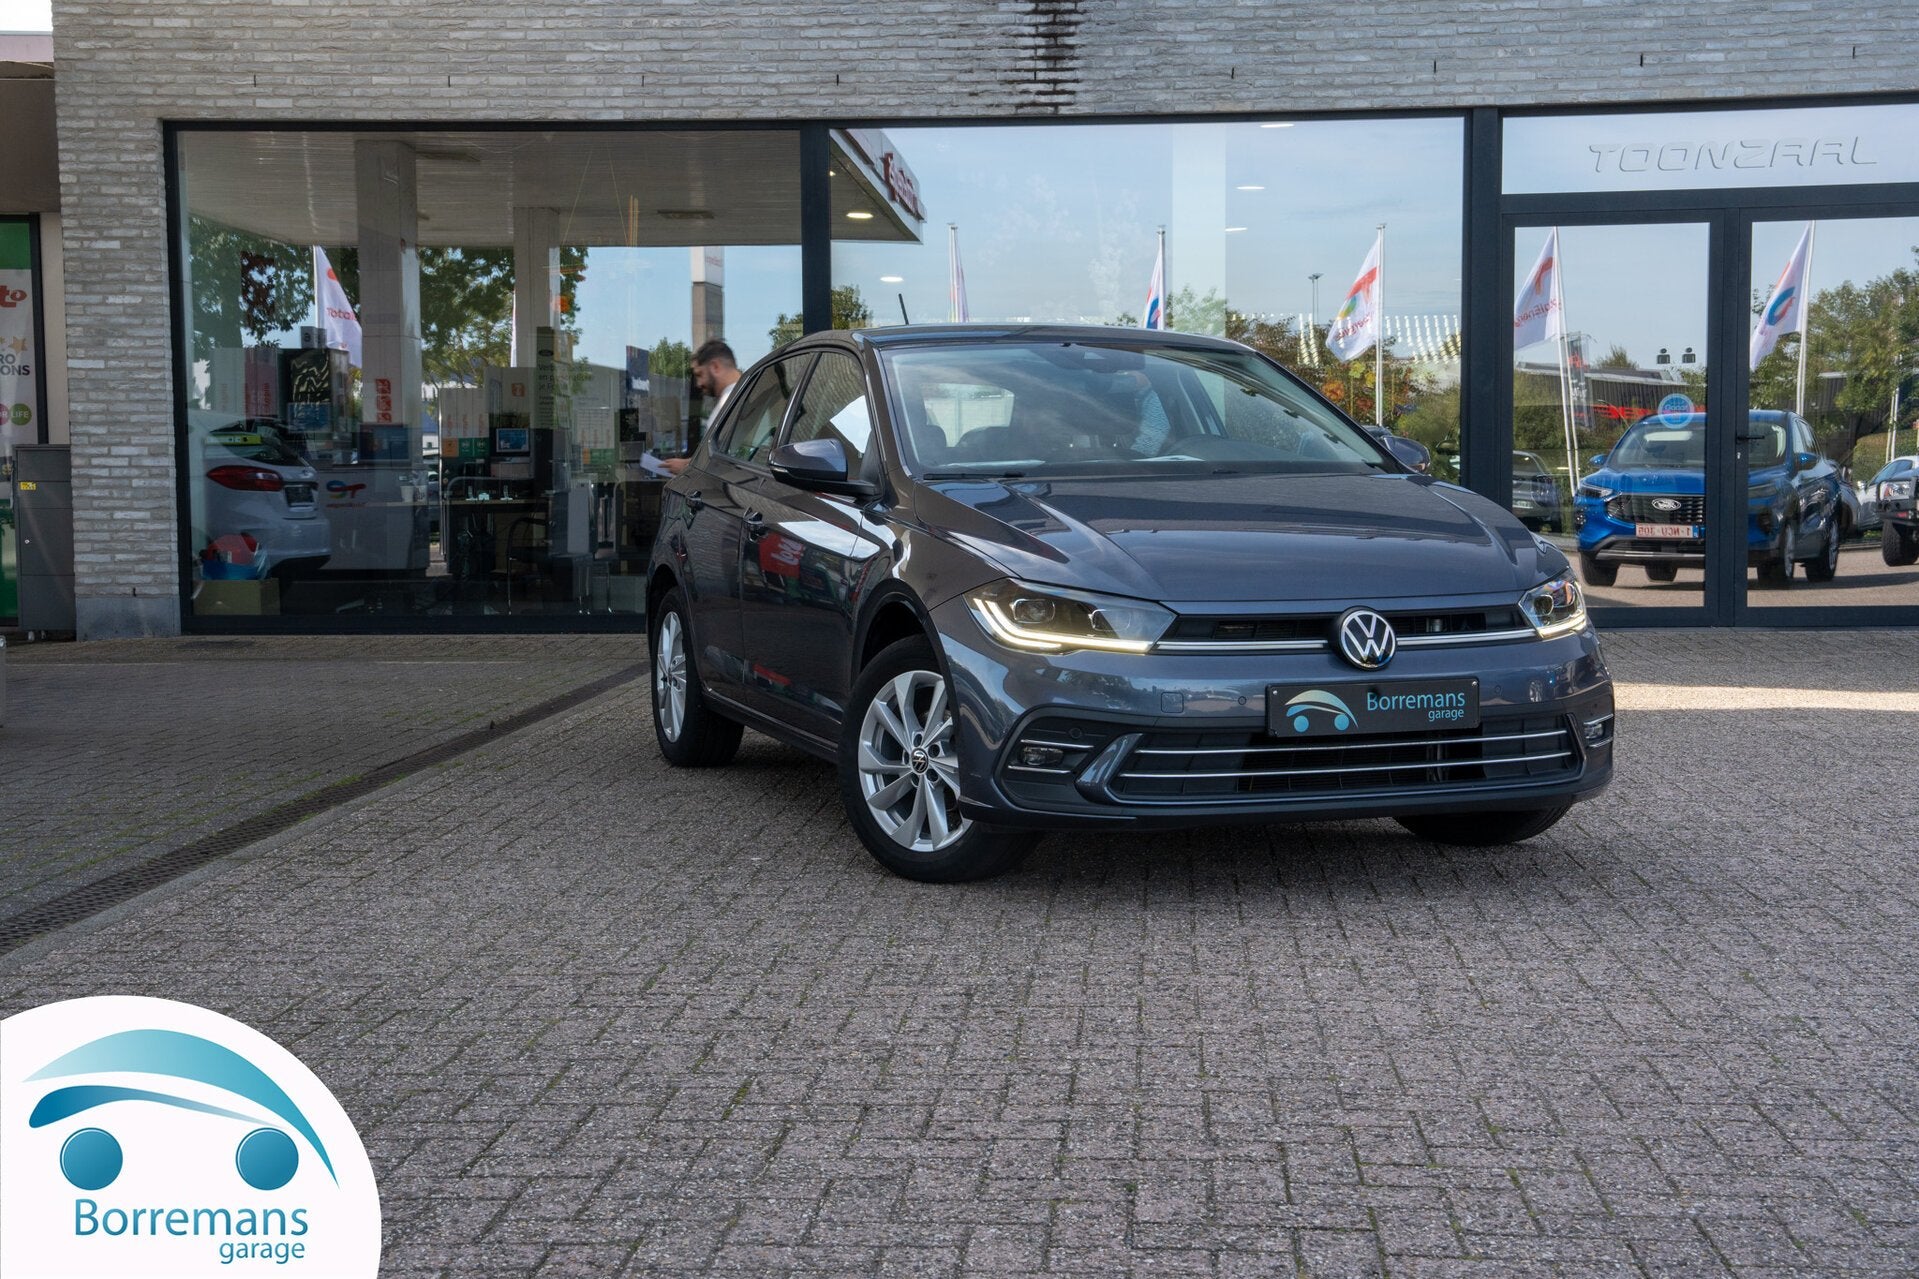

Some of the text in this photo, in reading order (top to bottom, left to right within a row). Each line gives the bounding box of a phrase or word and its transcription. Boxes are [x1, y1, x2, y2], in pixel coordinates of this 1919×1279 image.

[1589, 136, 1877, 174] TOONZAAL
[1367, 691, 1465, 711] Borremans
[1428, 709, 1464, 722] garage
